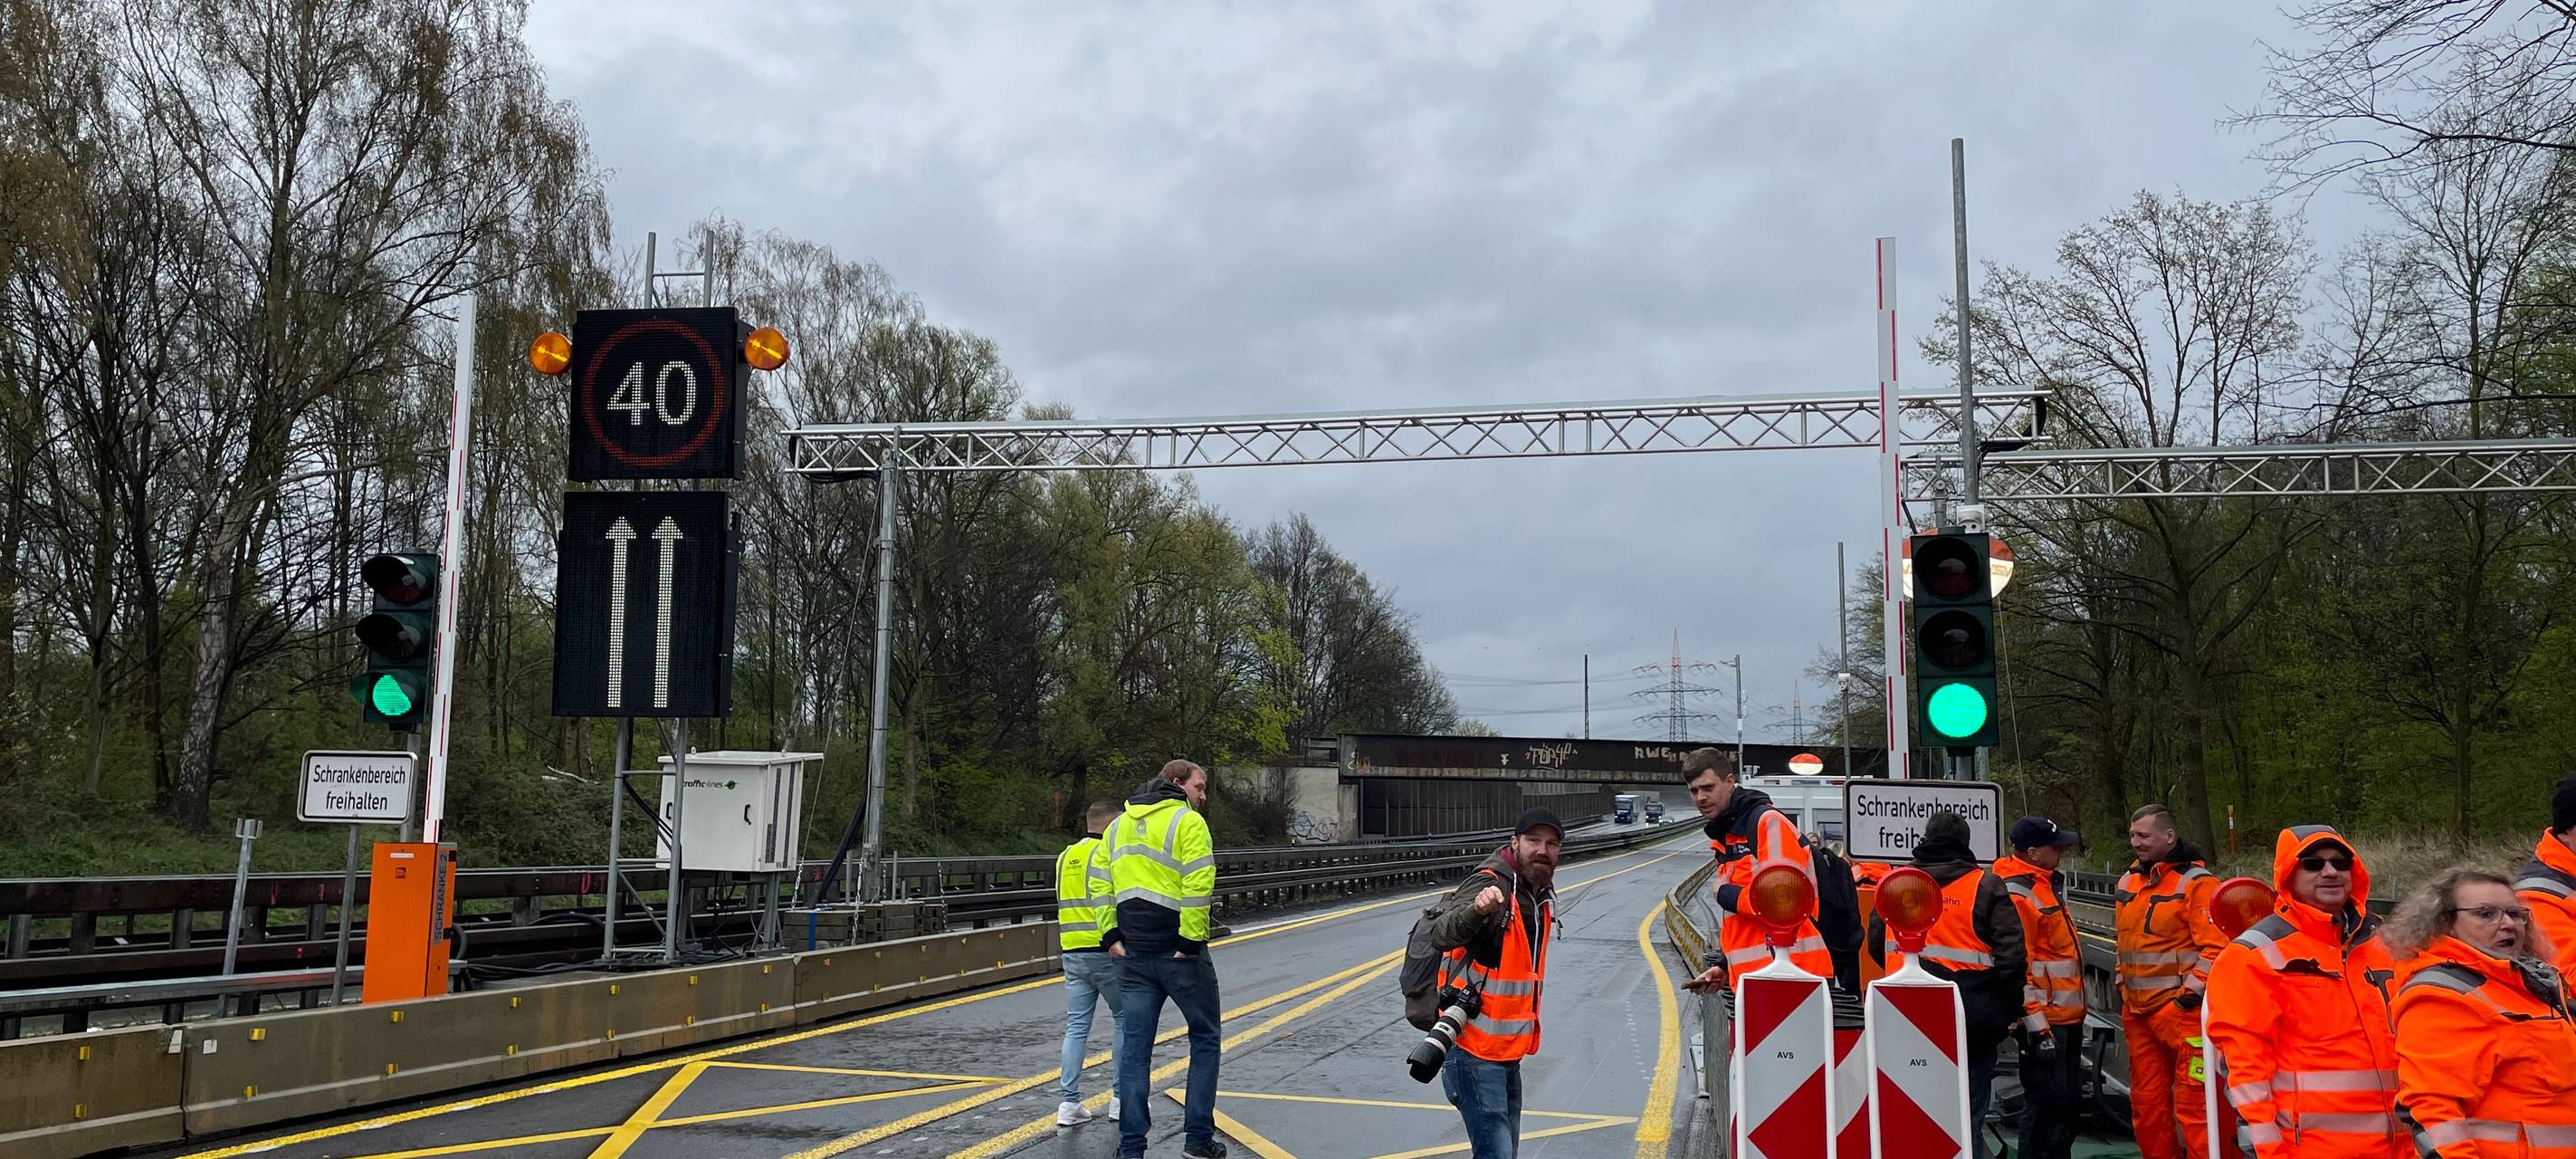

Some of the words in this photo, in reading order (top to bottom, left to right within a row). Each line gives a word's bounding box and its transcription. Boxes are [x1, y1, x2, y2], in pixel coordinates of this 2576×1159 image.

[606, 361, 697, 425] 40
[313, 764, 405, 784] Schrankenbereich
[326, 790, 388, 810] freihalten
[1879, 826, 1926, 849] freih
[1777, 1051, 1794, 1059] AVS
[1910, 1058, 1928, 1067] AVS
